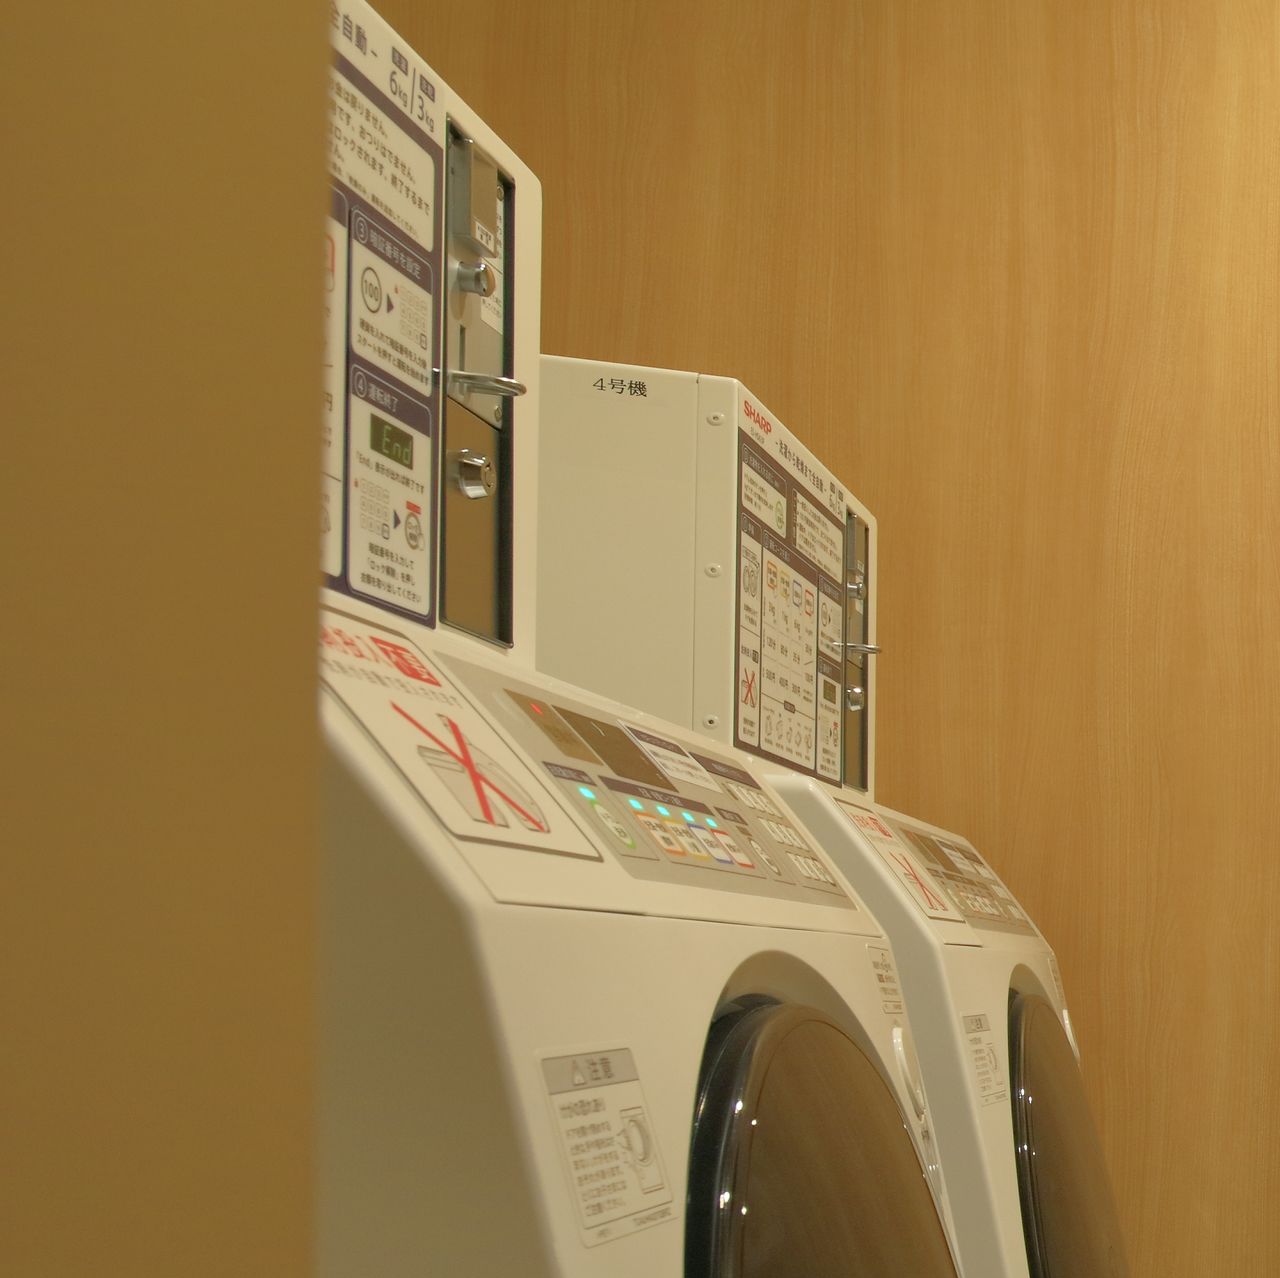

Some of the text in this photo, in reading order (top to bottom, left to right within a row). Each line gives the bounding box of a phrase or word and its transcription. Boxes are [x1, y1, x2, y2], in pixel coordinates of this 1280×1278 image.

[389, 70, 434, 133] 6kg 3kg
[363, 277, 379, 303] 100
[592, 377, 648, 397] 4号機
[743, 400, 772, 434] SHARP
